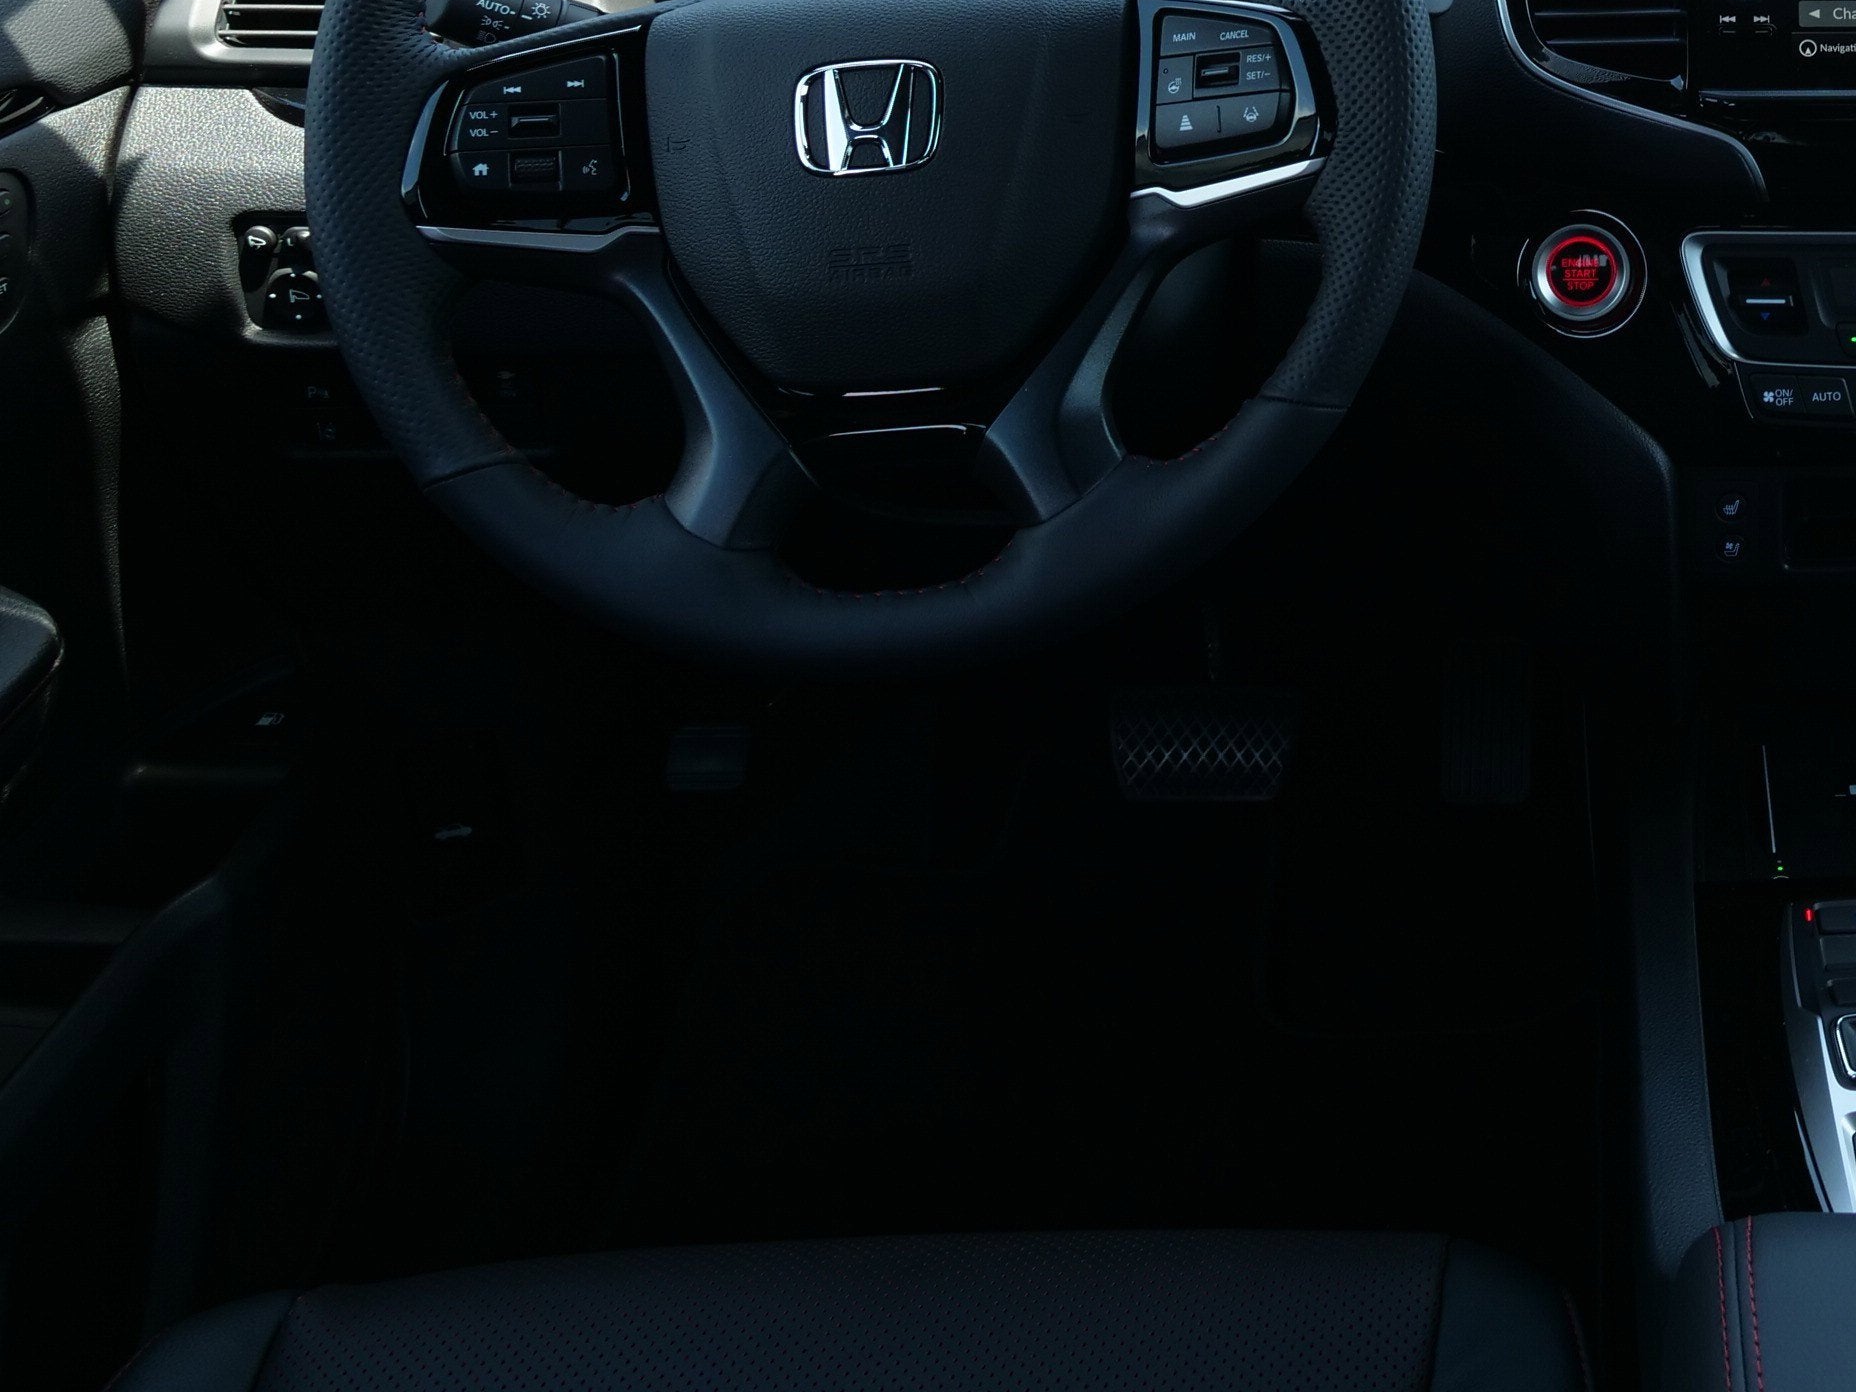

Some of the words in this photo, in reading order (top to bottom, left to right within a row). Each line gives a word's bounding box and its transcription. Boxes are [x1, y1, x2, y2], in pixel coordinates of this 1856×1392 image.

[1172, 32, 1196, 43] MAIN
[1219, 29, 1250, 41] CANCEL
[1246, 54, 1272, 64] RES/+
[1564, 269, 1596, 279] START
[1567, 281, 1595, 291] STOP
[1775, 389, 1794, 397] ON/
[1812, 391, 1842, 402] AUTO
[1775, 397, 1794, 406] OFF
